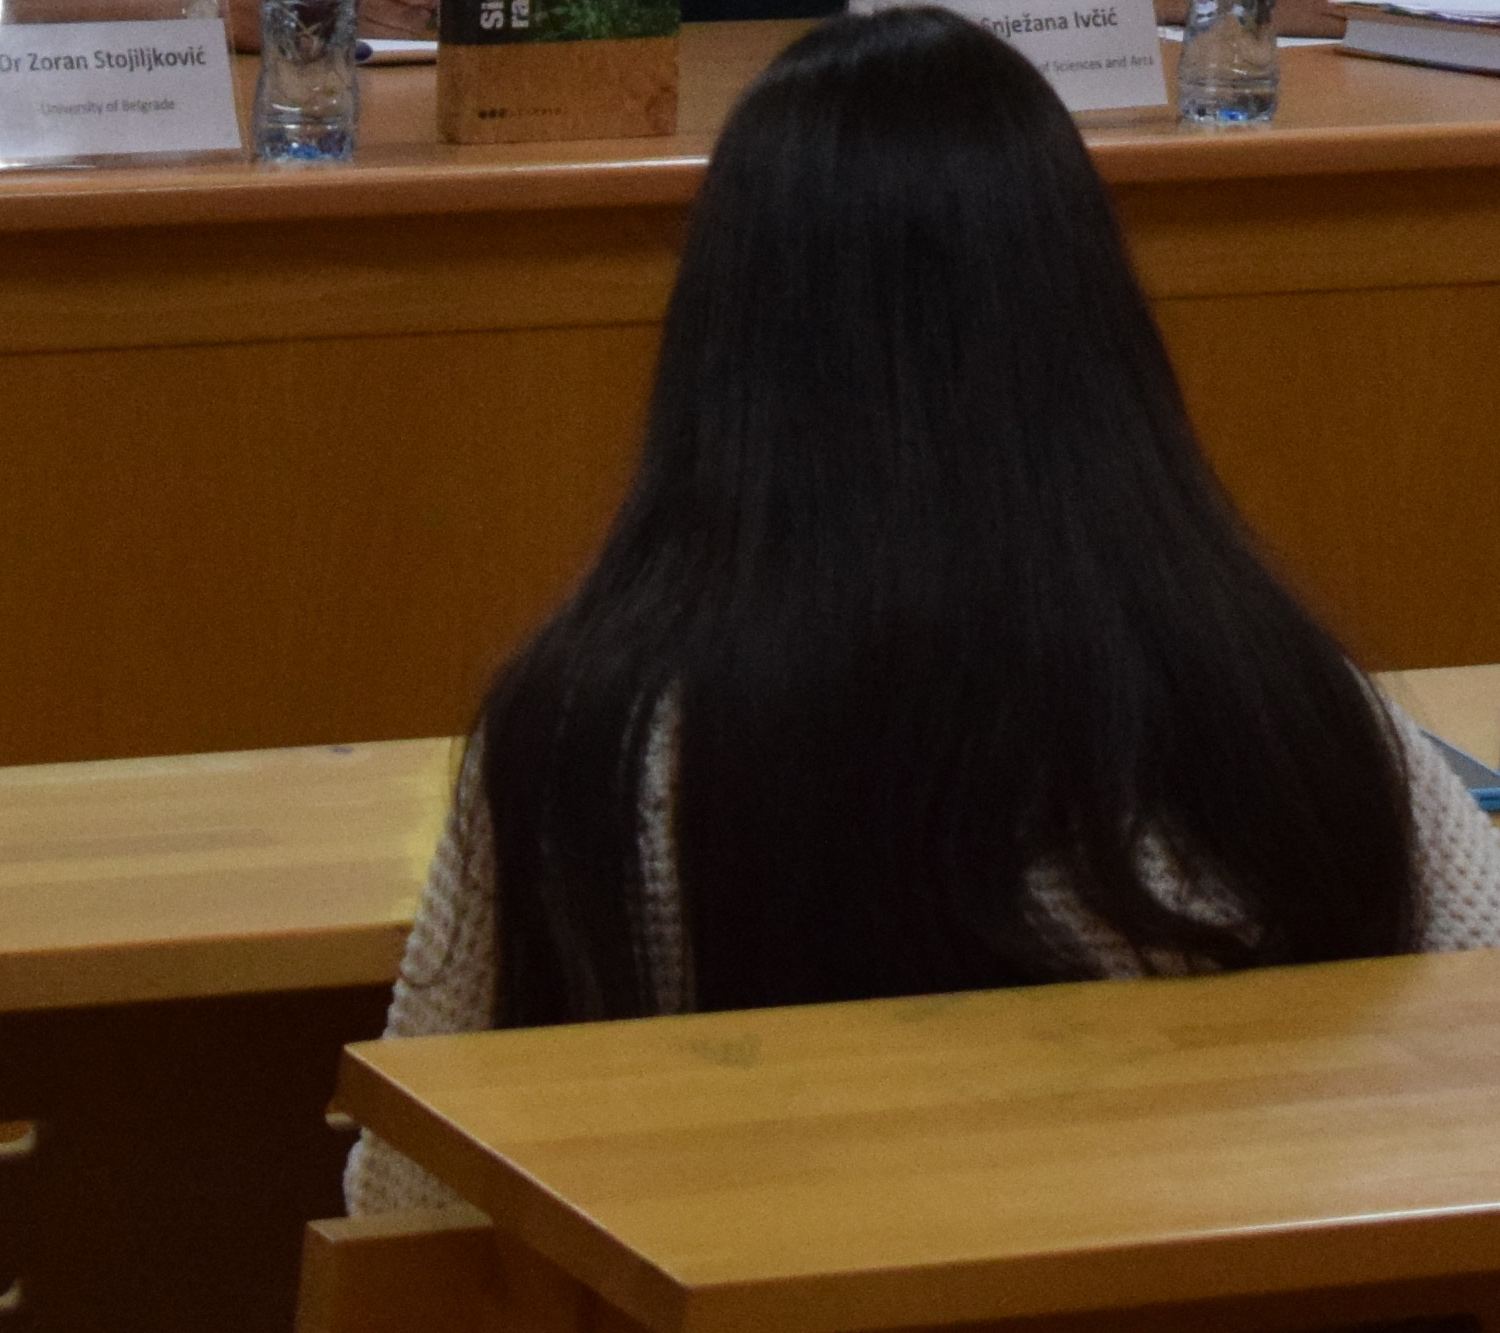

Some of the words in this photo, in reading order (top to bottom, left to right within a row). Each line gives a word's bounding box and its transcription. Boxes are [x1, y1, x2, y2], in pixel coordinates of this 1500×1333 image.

[1074, 7, 1118, 29] Ivčić
[28, 52, 88, 71] Zoran
[94, 45, 207, 73] Stojiljković
